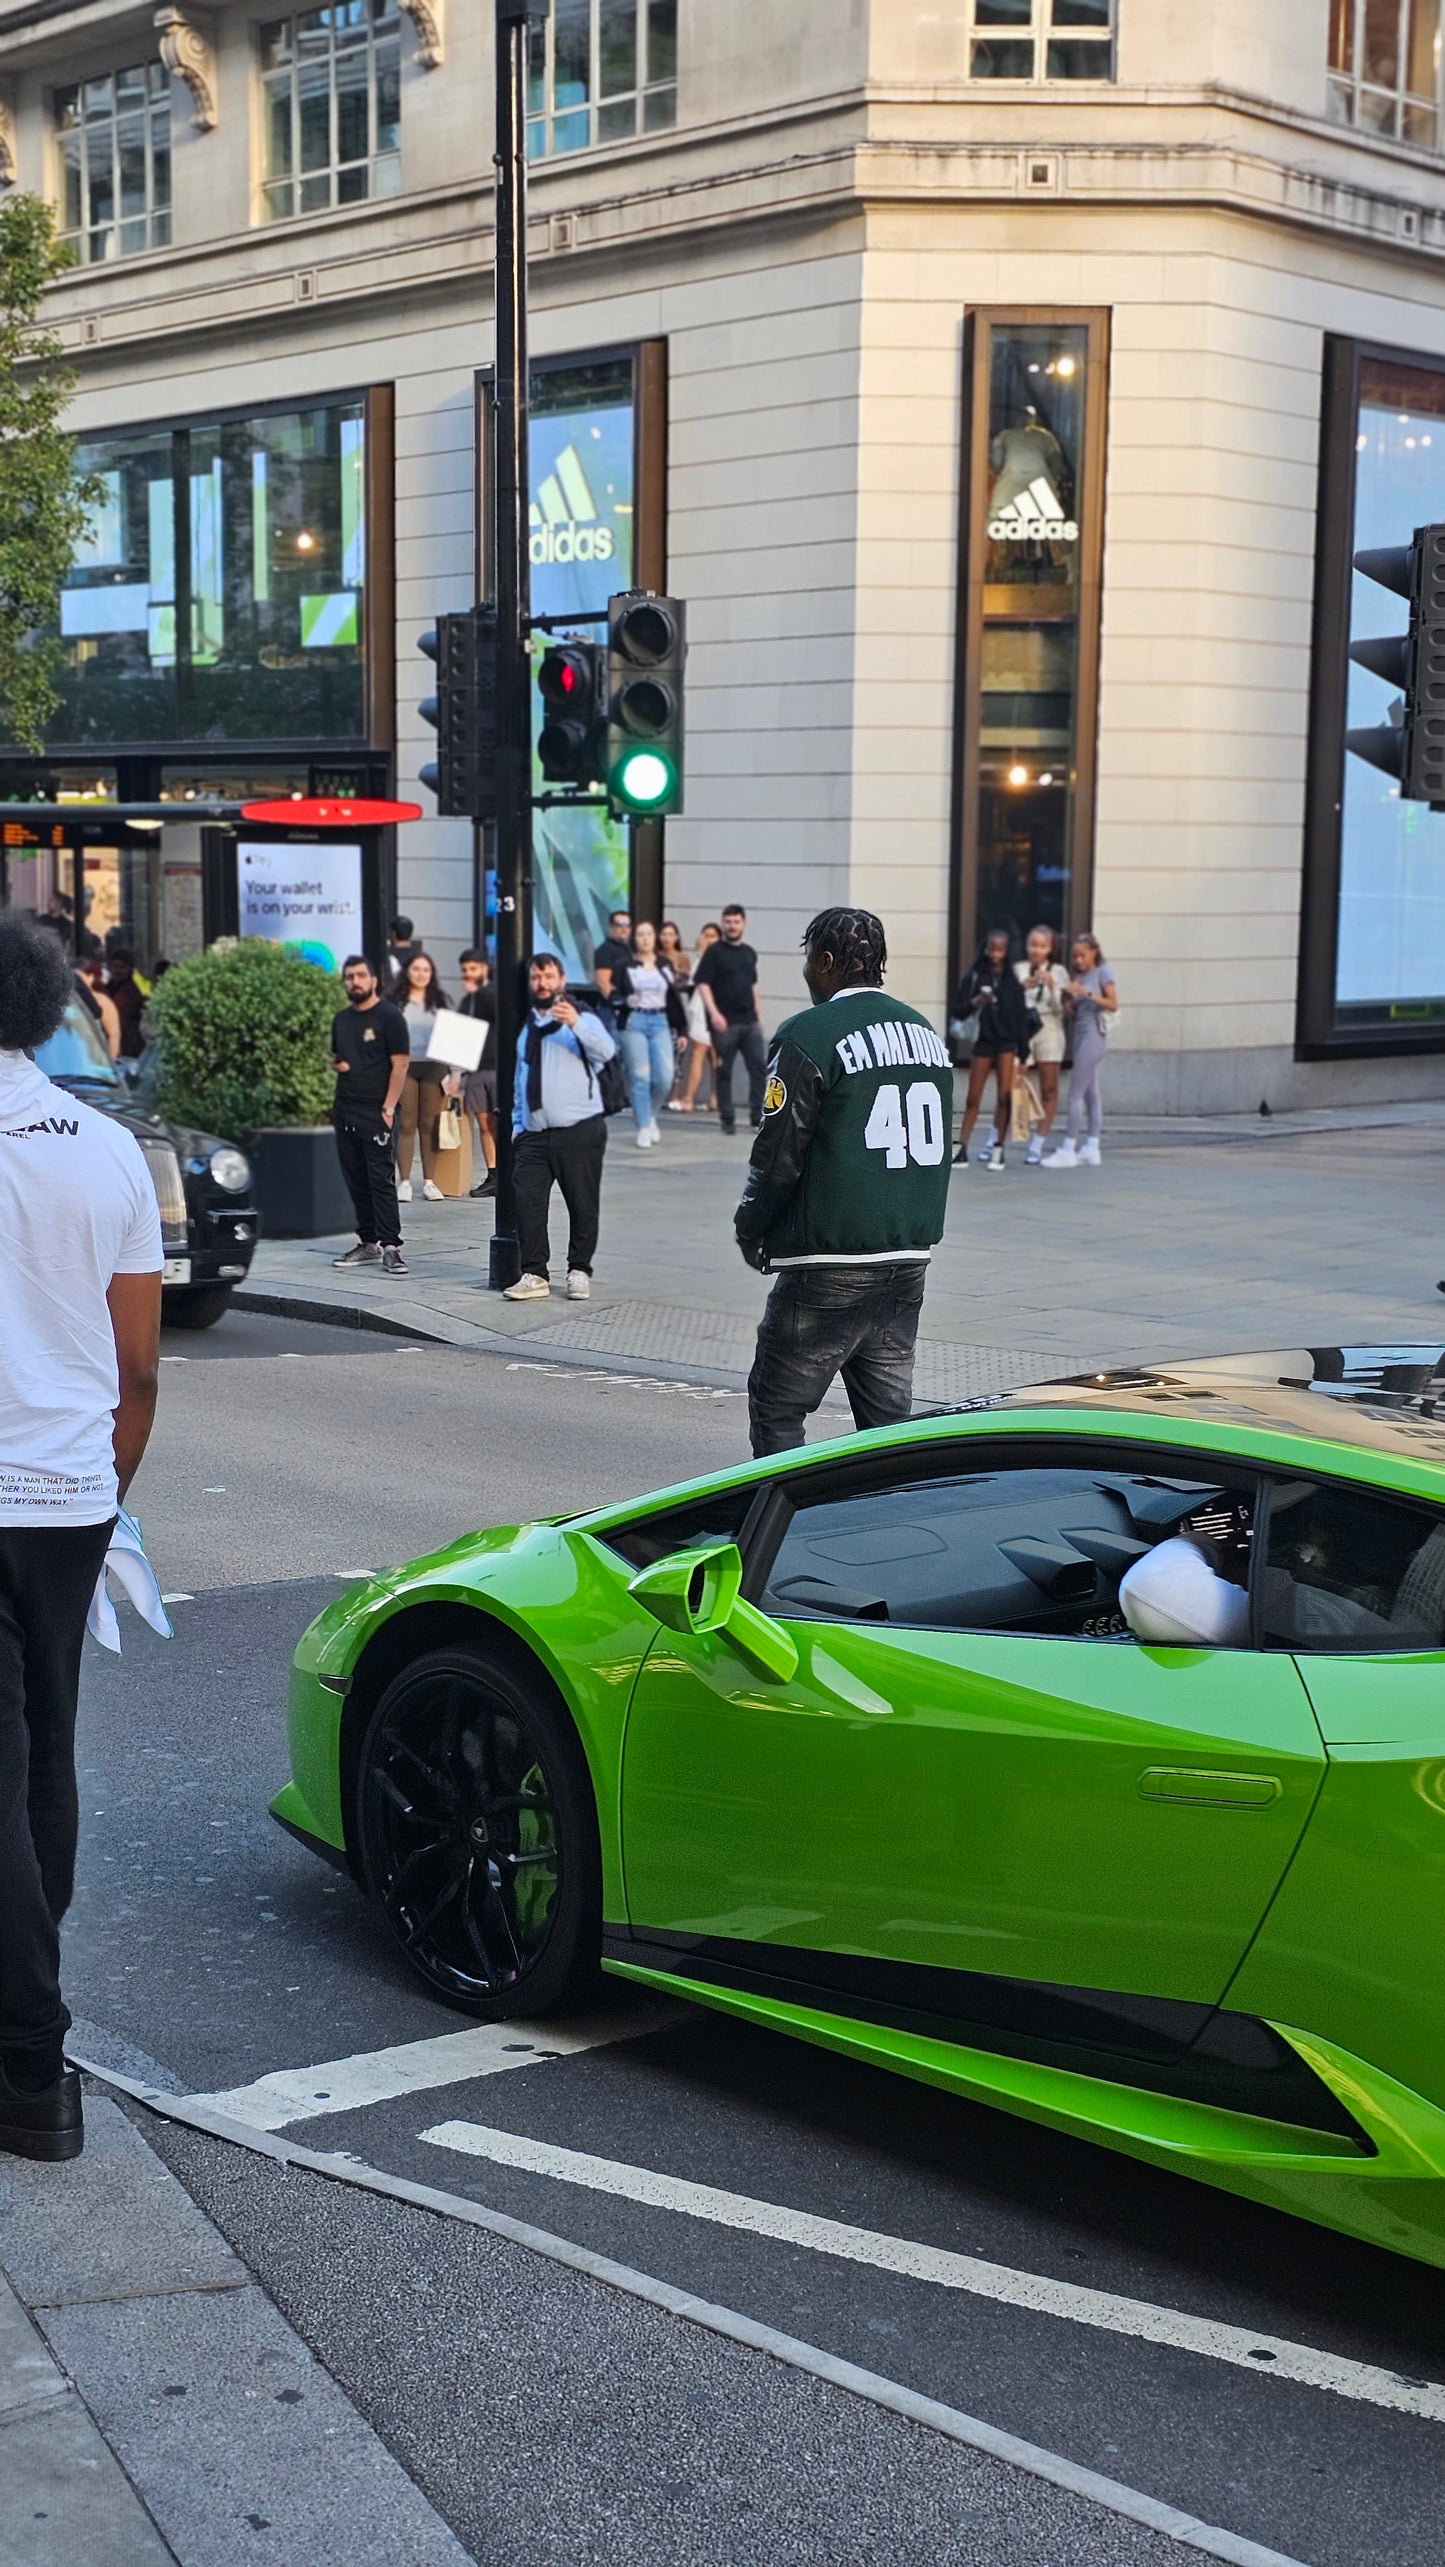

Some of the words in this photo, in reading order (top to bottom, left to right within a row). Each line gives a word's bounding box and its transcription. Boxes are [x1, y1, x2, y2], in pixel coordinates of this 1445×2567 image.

[987, 517, 1079, 541] adidas
[529, 520, 613, 565] didas
[245, 880, 277, 895] Your
[280, 881, 323, 895] wallet
[246, 900, 259, 915] is
[261, 902, 281, 915] on
[282, 902, 314, 917] your
[835, 1030, 873, 1075] EM
[864, 1081, 944, 1169] 40
[42, 1477, 63, 1485] THAT
[22, 1486, 39, 1494] YOU
[40, 1486, 62, 1494] LIKED
[14, 1497, 28, 1505] MY
